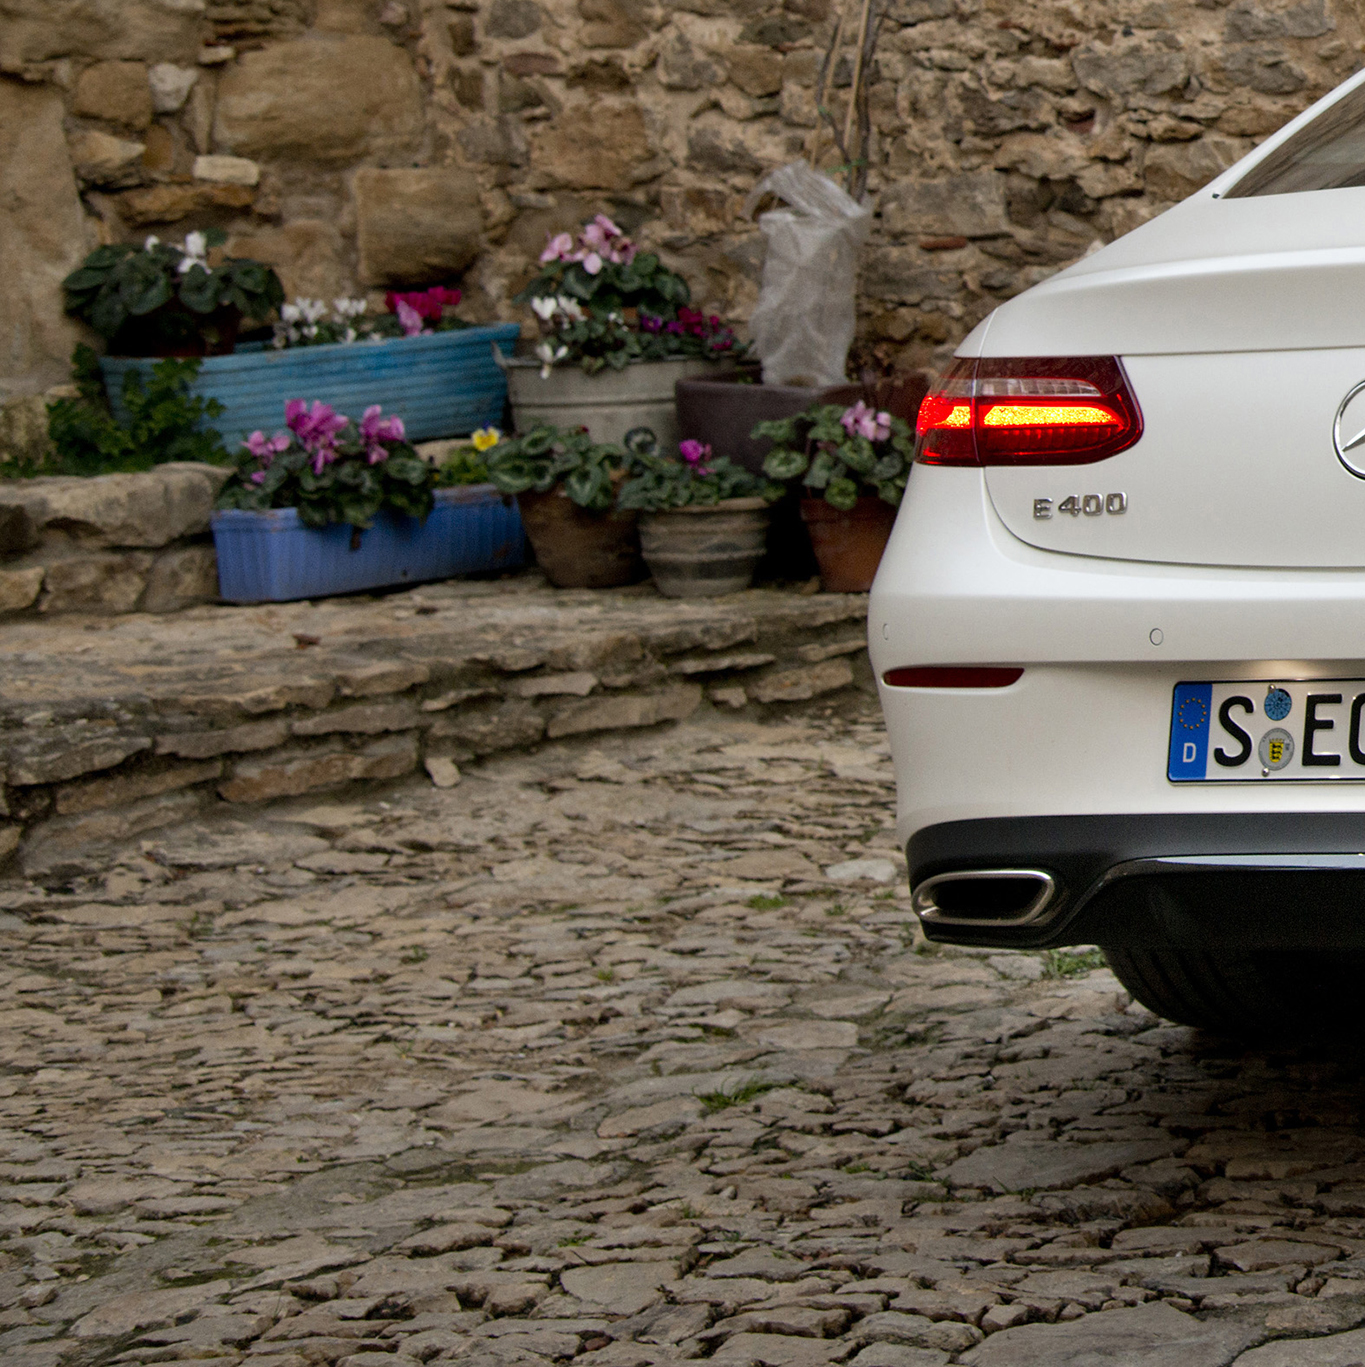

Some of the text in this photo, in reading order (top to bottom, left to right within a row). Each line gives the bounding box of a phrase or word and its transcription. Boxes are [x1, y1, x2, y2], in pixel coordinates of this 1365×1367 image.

[1033, 492, 1128, 520] E 400
[1213, 695, 1255, 767] S
[1182, 742, 1197, 763] D
